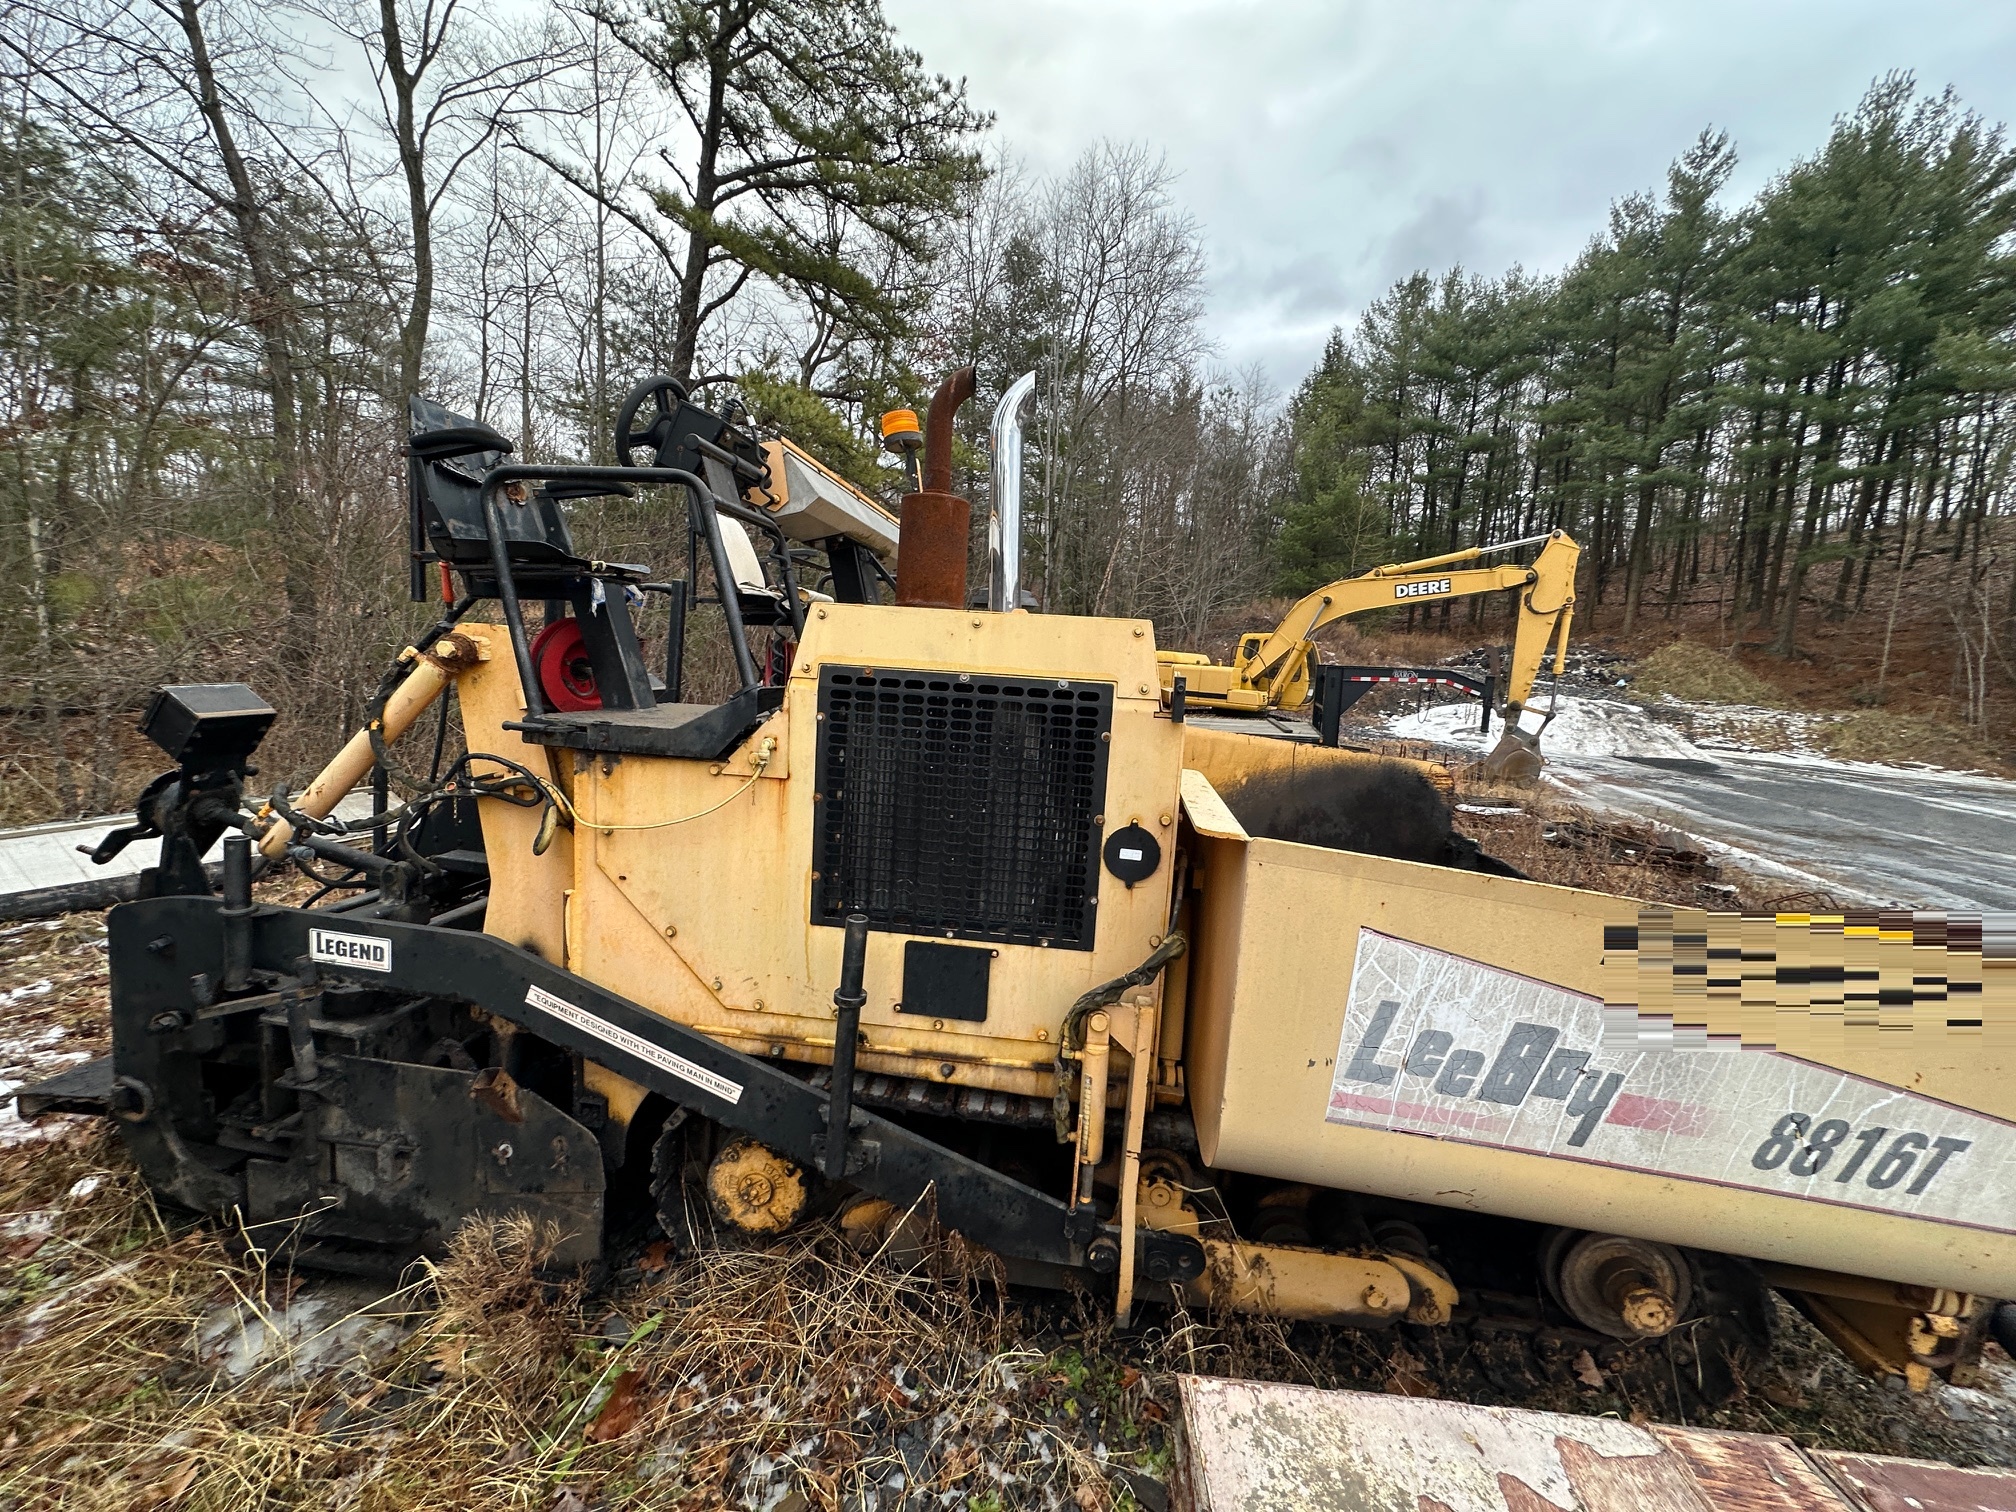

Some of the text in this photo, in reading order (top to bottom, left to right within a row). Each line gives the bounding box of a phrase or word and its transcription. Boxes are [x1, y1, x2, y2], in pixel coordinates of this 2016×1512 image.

[1395, 579, 1450, 598] DEERE
[316, 932, 385, 962] LEGEND
[580, 1016, 618, 1039] DESIGNED
[620, 1034, 640, 1050] WITH
[641, 1045, 656, 1058] THE
[657, 1053, 686, 1072] PAVING
[686, 1067, 704, 1082] MAN
[705, 1077, 713, 1085] IN
[1344, 1000, 1626, 1147] LeeBoy
[1751, 1112, 1973, 1195] 8816T
